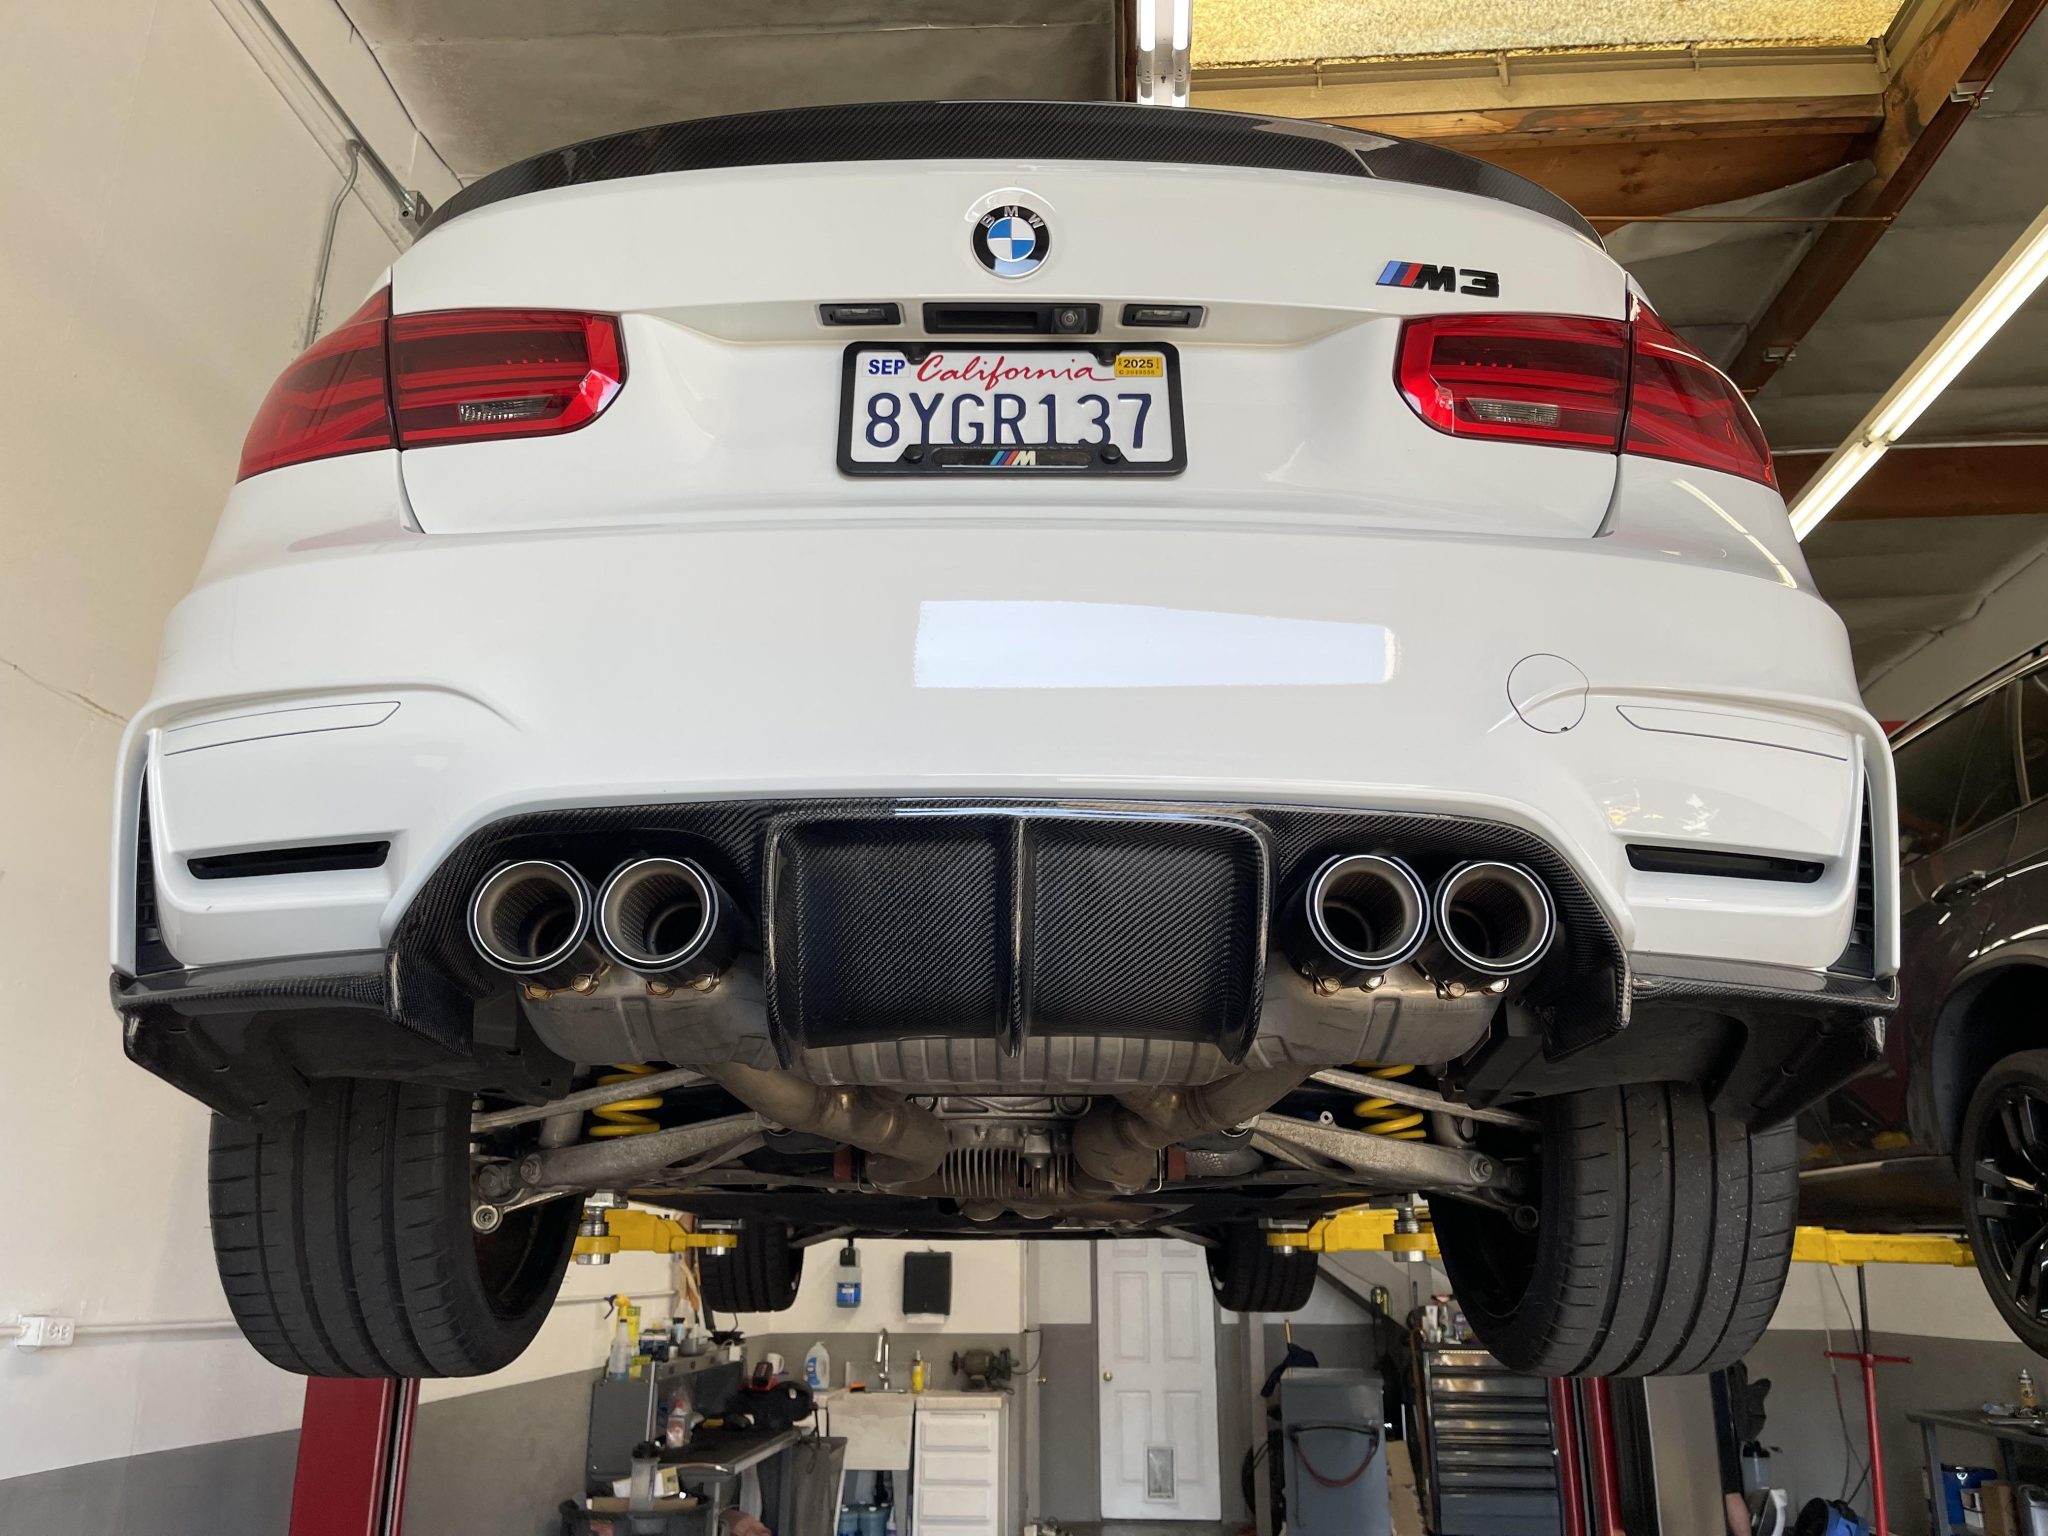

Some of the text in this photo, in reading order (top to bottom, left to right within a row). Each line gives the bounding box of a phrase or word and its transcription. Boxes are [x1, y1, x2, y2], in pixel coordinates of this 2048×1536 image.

[980, 206, 1045, 229] BMW
[1411, 263, 1500, 298] M3
[868, 359, 906, 375] SEP
[917, 354, 1116, 391] California
[1123, 359, 1154, 369] 2025
[865, 392, 1152, 449] 8YGR137
